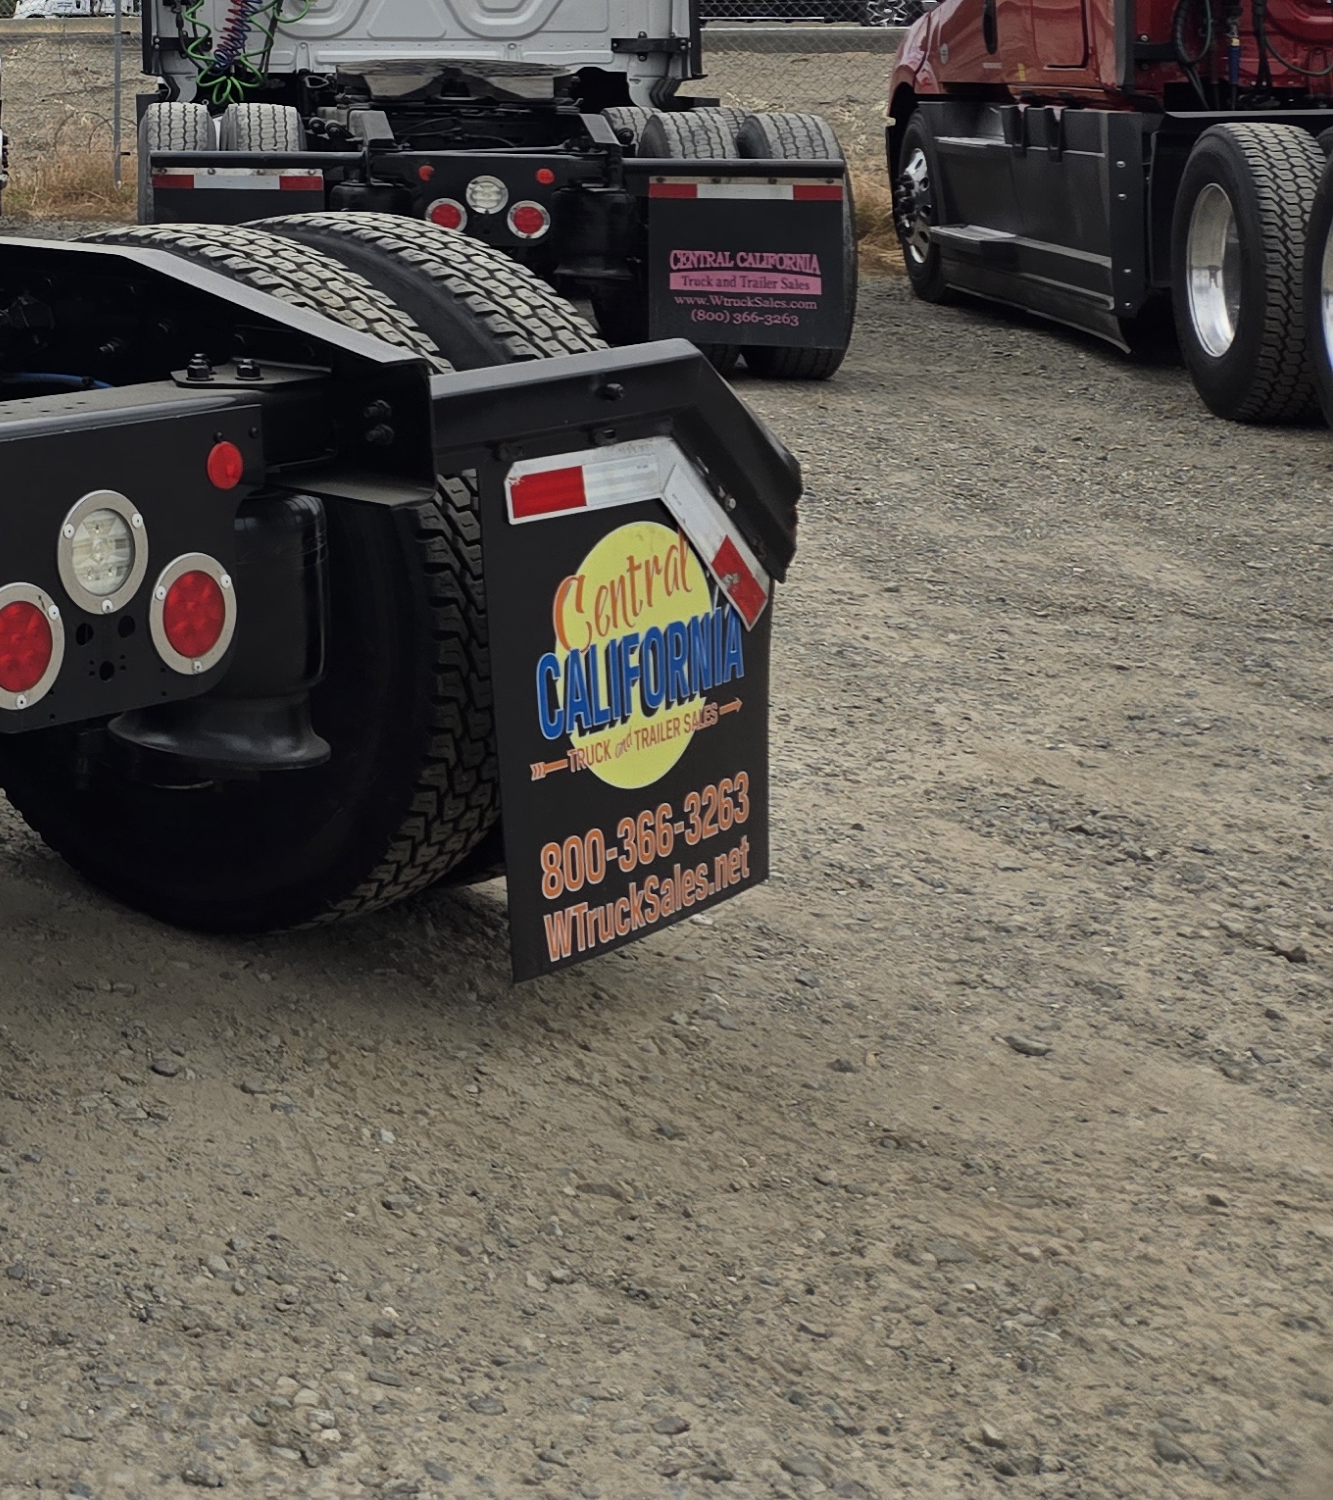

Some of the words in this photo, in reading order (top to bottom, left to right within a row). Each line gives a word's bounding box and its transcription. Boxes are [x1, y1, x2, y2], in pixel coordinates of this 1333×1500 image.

[669, 250, 734, 270] CENTRAL
[736, 251, 821, 275] CALIFORNIA
[681, 275, 713, 287] Truck
[715, 276, 736, 287] and
[738, 275, 778, 289] Trailer
[779, 278, 810, 290] Sales
[691, 308, 730, 324] (800)
[733, 311, 799, 326] 366-3263
[553, 526, 692, 653] Central
[536, 605, 745, 740] CALIFORNIA
[567, 738, 611, 773] TRUCK
[614, 726, 634, 759] and
[634, 718, 681, 751] TRAILER
[683, 702, 719, 734] SALES
[540, 771, 750, 900] 800-366-3263
[543, 835, 750, 962] WTruckSales.net
